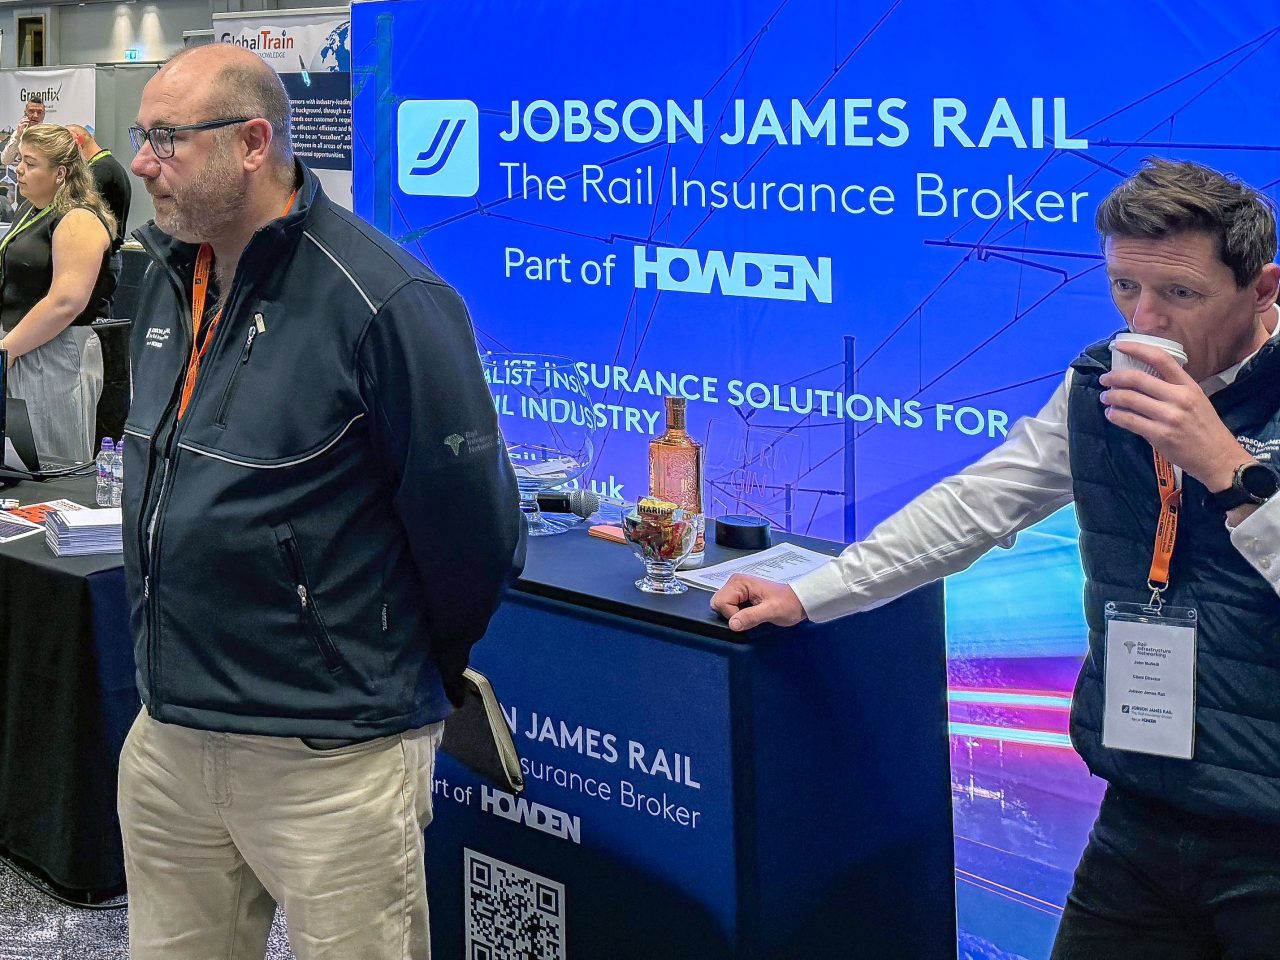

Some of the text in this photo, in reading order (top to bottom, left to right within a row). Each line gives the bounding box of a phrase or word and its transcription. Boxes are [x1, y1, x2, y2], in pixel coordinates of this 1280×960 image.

[499, 97, 1088, 149] JOBSON JAMES RAIL
[499, 162, 1088, 223] The Rail Insurance Broker
[504, 244, 832, 304] Part of HOWDEN
[727, 379, 923, 429] SOLUTIONS
[936, 402, 1009, 438] FOR
[524, 712, 619, 764] JAMES
[628, 739, 701, 789] RAIL
[453, 784, 473, 806] of
[480, 783, 581, 845] HOWDEN
[620, 780, 701, 829] Broker
